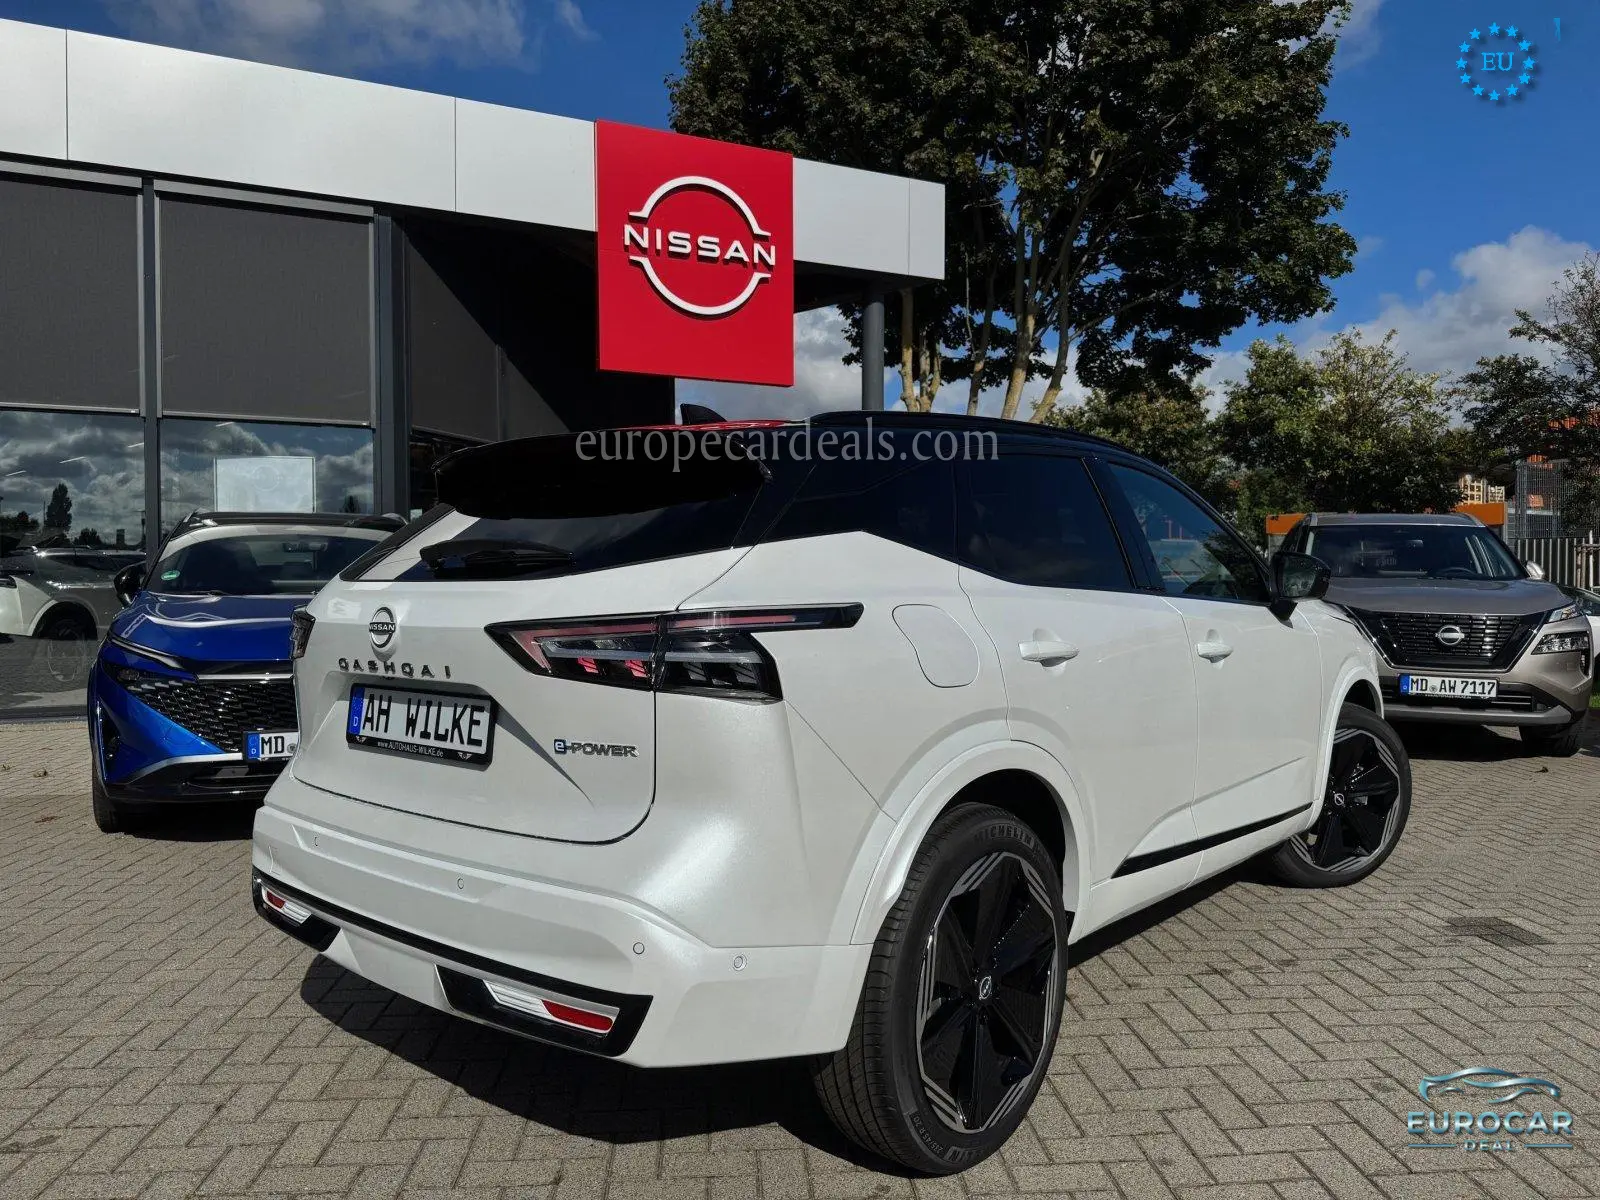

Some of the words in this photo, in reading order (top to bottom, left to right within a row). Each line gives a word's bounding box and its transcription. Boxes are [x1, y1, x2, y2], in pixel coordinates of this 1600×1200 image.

[624, 224, 775, 266] NISSAN
[369, 622, 395, 632] NISSAN
[338, 658, 451, 679] QASHQAI
[1410, 678, 1428, 692] MD
[1439, 679, 1457, 693] AW
[1460, 680, 1496, 695] 7117
[352, 716, 359, 727] D
[362, 693, 392, 733] AH
[405, 697, 485, 747] WILKE
[261, 735, 285, 754] MD
[377, 740, 444, 758] www.AUTOHAUS-WILKE.de
[554, 739, 639, 757] e-POWER
